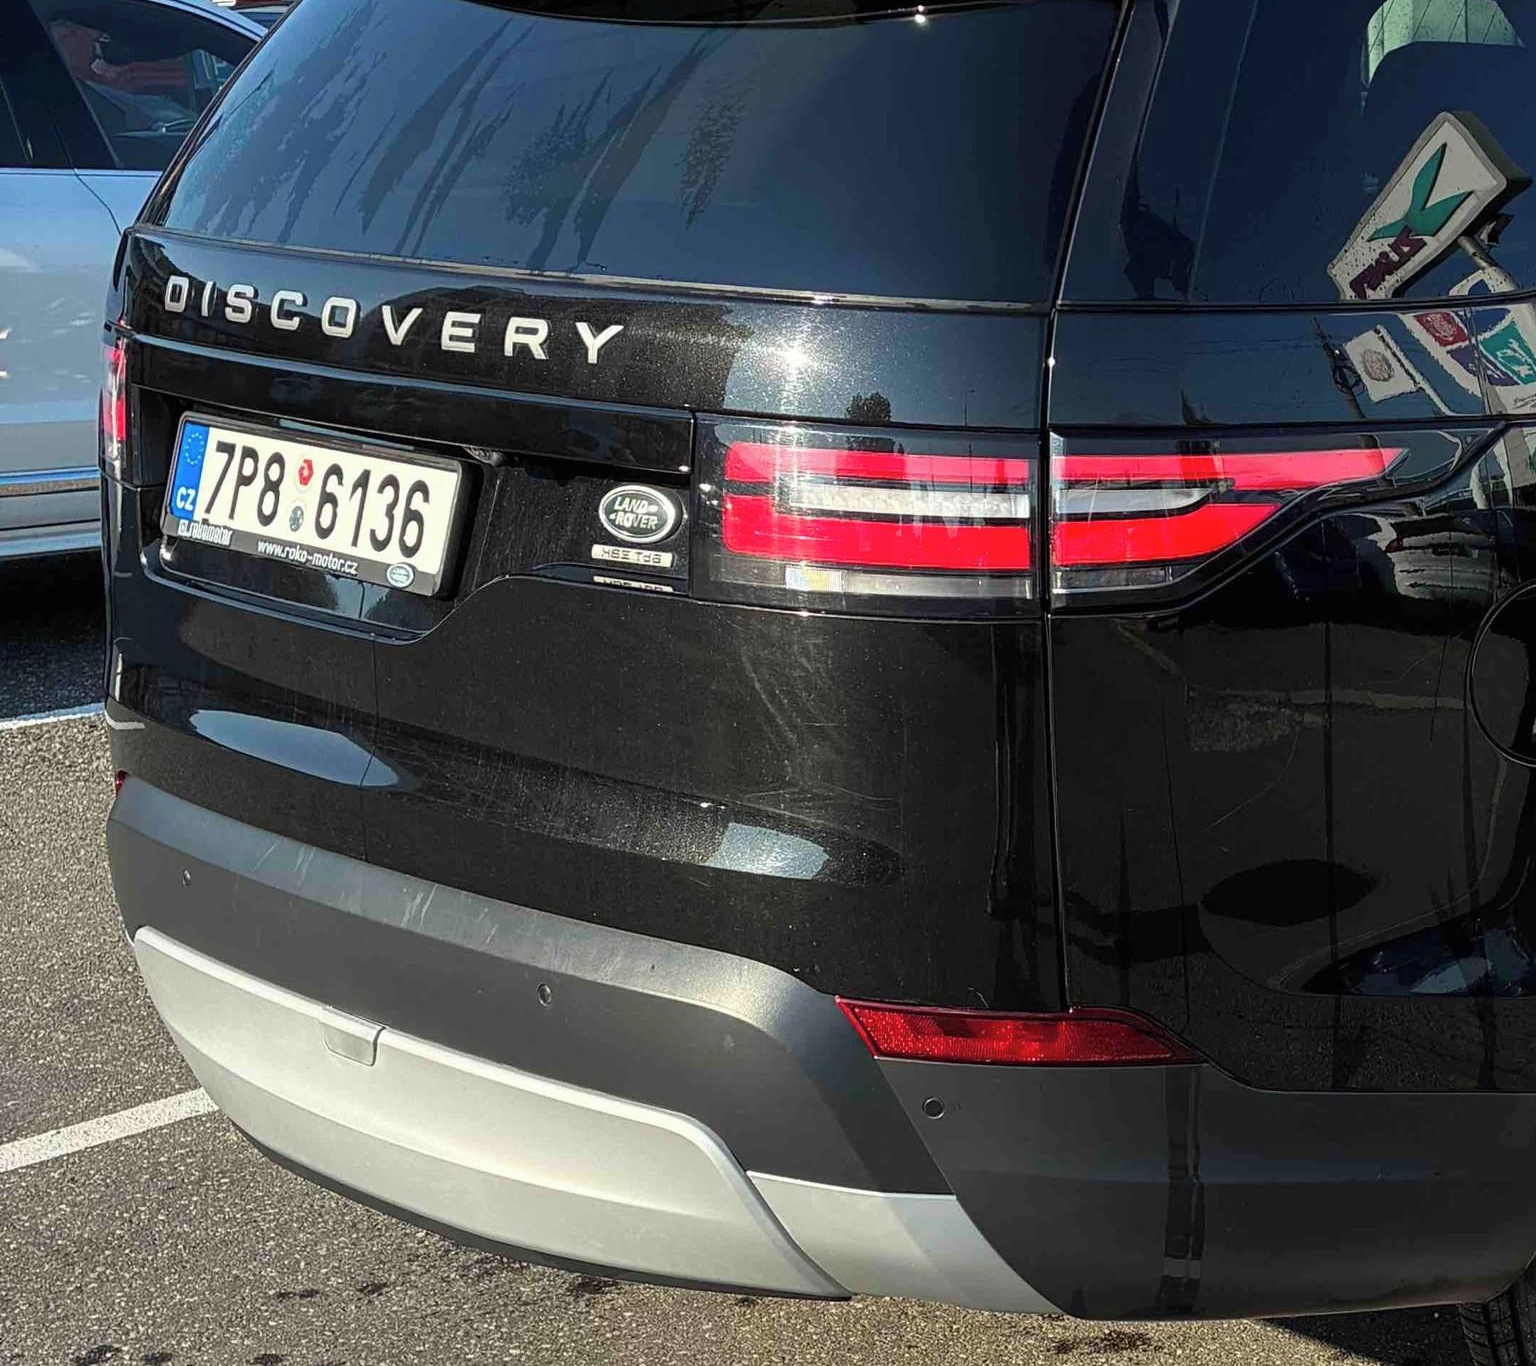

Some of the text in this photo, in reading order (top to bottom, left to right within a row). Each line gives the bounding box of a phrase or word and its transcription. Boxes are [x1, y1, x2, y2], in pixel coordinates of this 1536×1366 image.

[163, 275, 625, 365] DISCOVERY
[176, 487, 196, 512] CZ
[204, 440, 430, 559] 7P8 6136
[613, 496, 649, 513] LAND
[615, 511, 659, 530] ROVER
[257, 540, 359, 575] www.roko-motor.cz
